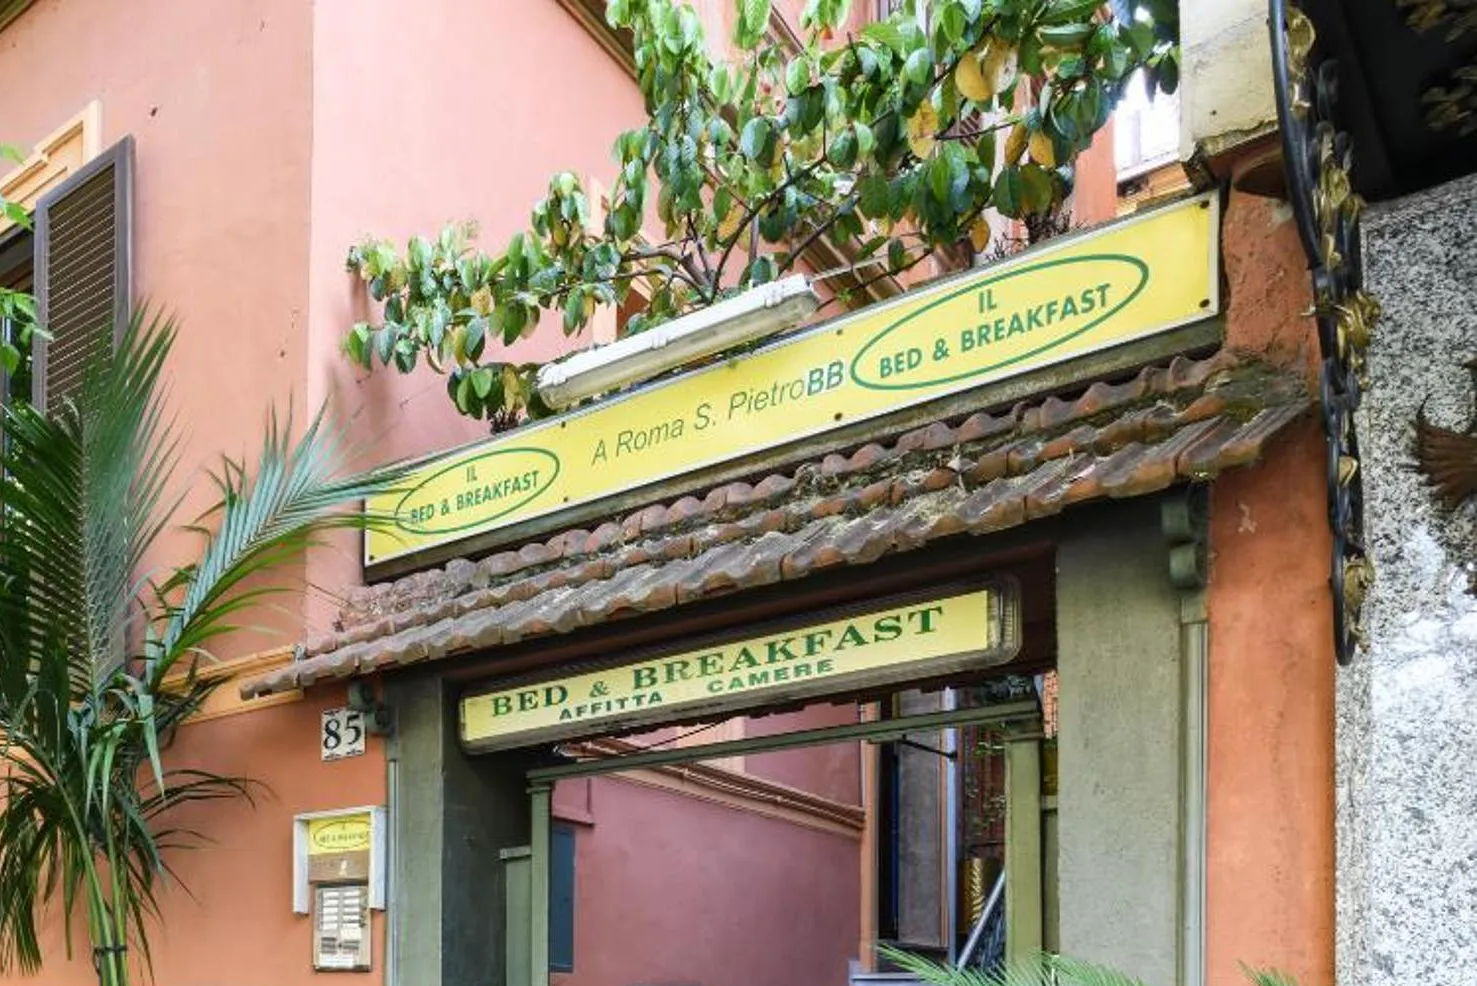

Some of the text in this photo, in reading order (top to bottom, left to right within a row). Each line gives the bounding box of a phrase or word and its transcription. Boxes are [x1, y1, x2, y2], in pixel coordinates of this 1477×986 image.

[979, 289, 997, 313] IL
[880, 283, 1111, 378] BED & BREAKFAST
[591, 439, 607, 466] A
[616, 418, 684, 457] Roma
[694, 403, 716, 430] S.
[411, 470, 539, 524] BED & BREAKFAST
[466, 465, 478, 483] IL
[491, 606, 943, 717] BED & BREAKFAST
[559, 659, 834, 720] AFFITTA CAMERE
[323, 713, 361, 750] 85
